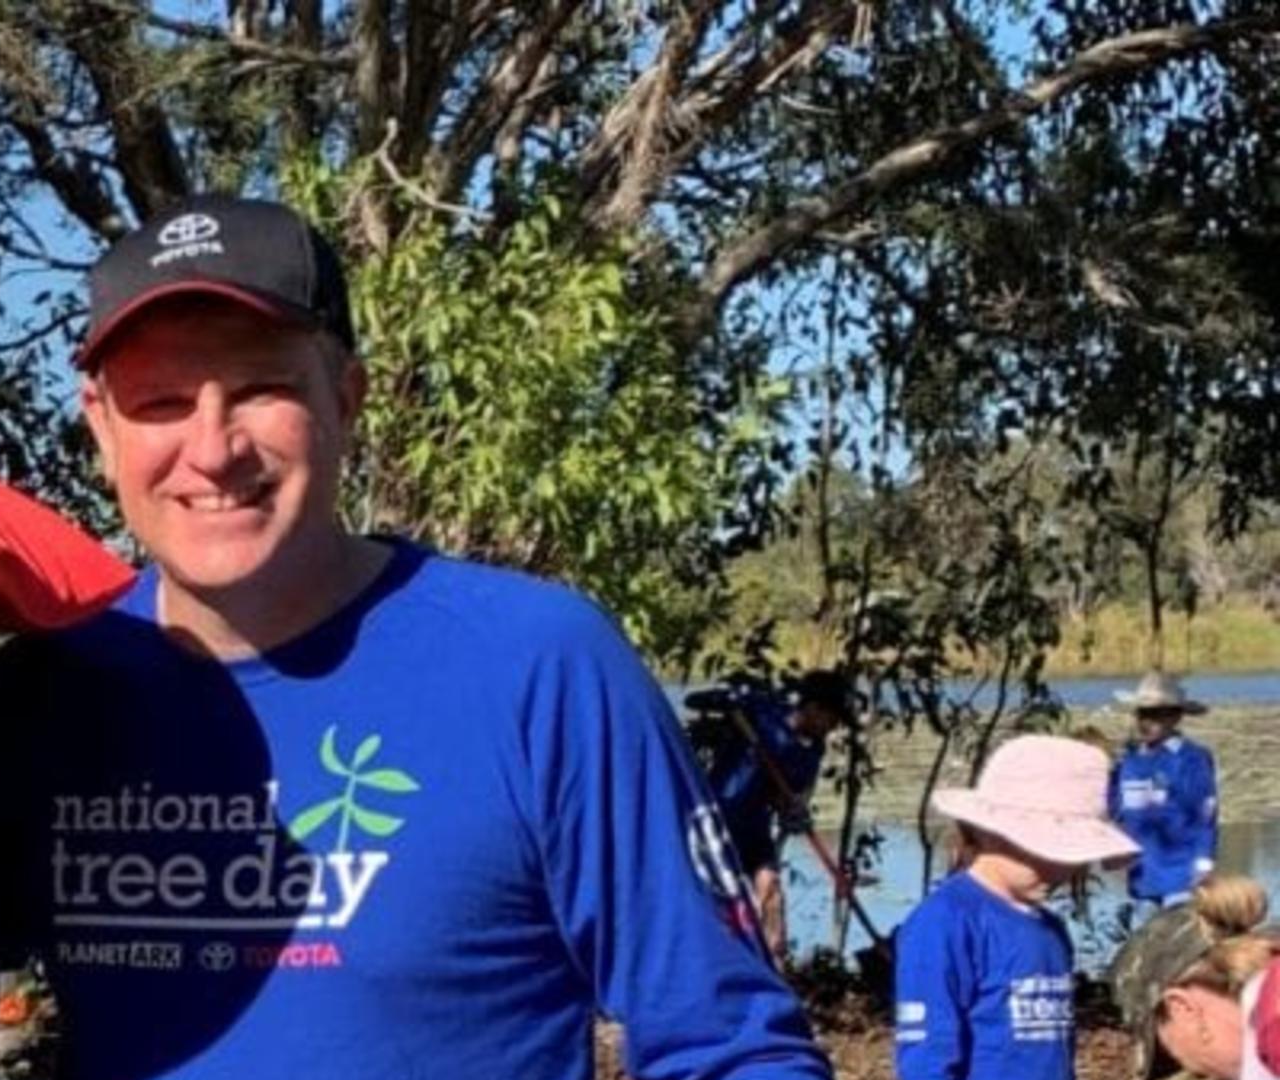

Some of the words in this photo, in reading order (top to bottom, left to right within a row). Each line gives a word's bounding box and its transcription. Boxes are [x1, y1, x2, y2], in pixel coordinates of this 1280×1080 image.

[151, 241, 224, 267] TOYOTA
[51, 780, 280, 832] national
[51, 838, 208, 908] tree
[222, 835, 390, 928] day
[244, 942, 343, 968] TOYOTA
